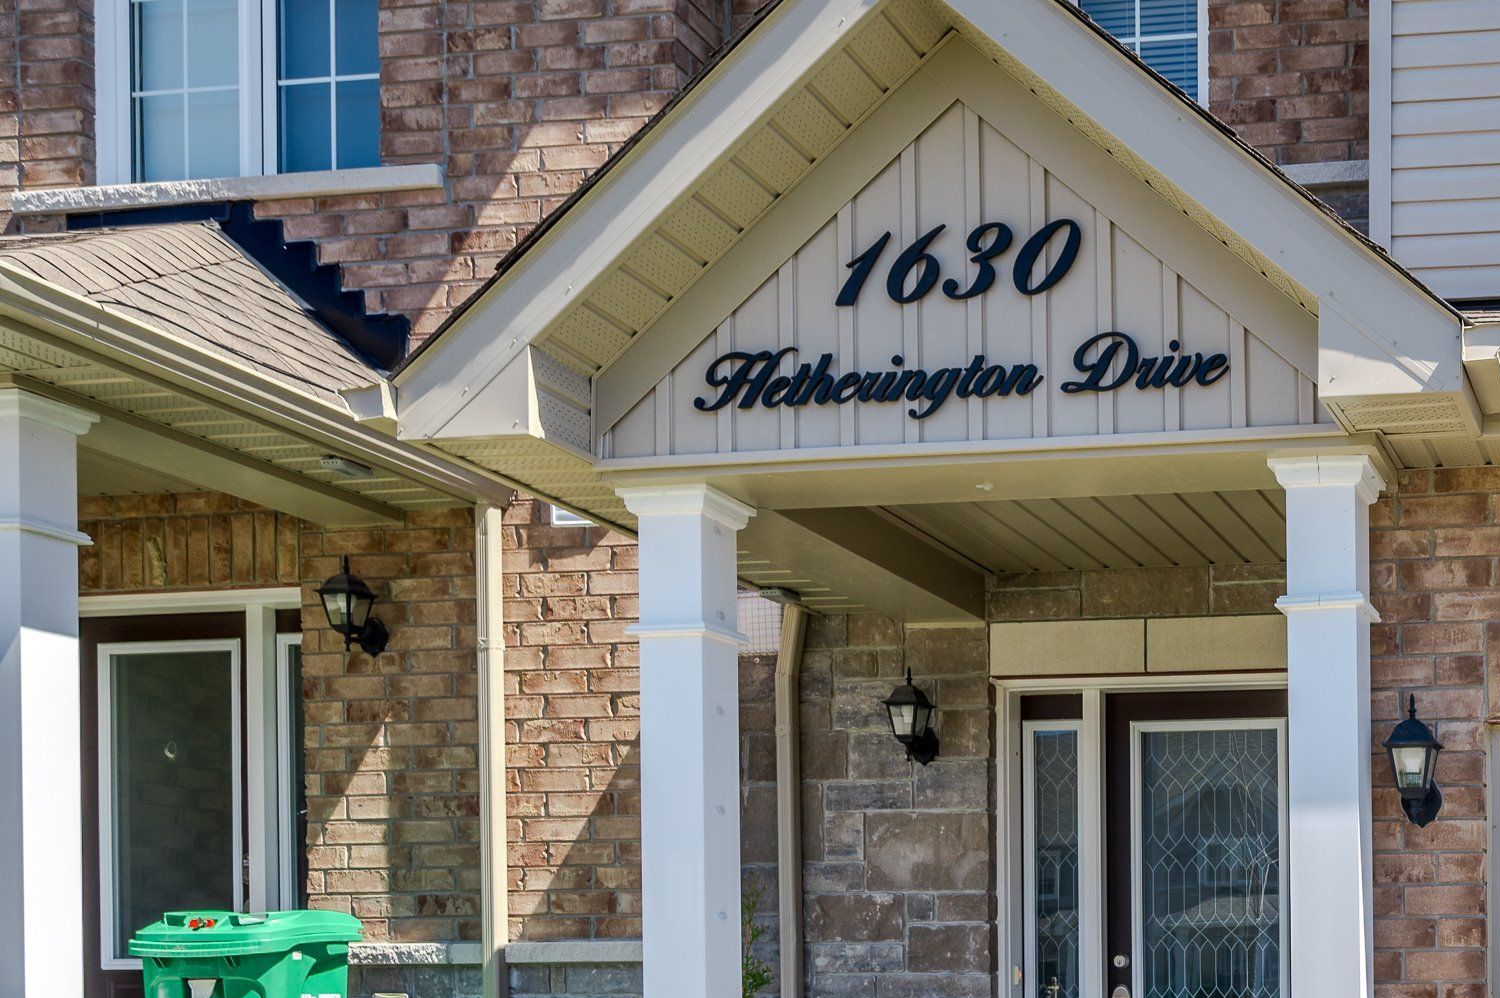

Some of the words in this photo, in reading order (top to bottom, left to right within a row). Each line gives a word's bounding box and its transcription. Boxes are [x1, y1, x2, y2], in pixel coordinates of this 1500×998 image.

[835, 218, 1083, 306] 1630
[694, 346, 1043, 420] Hetherington
[1060, 331, 1231, 393] Drive
